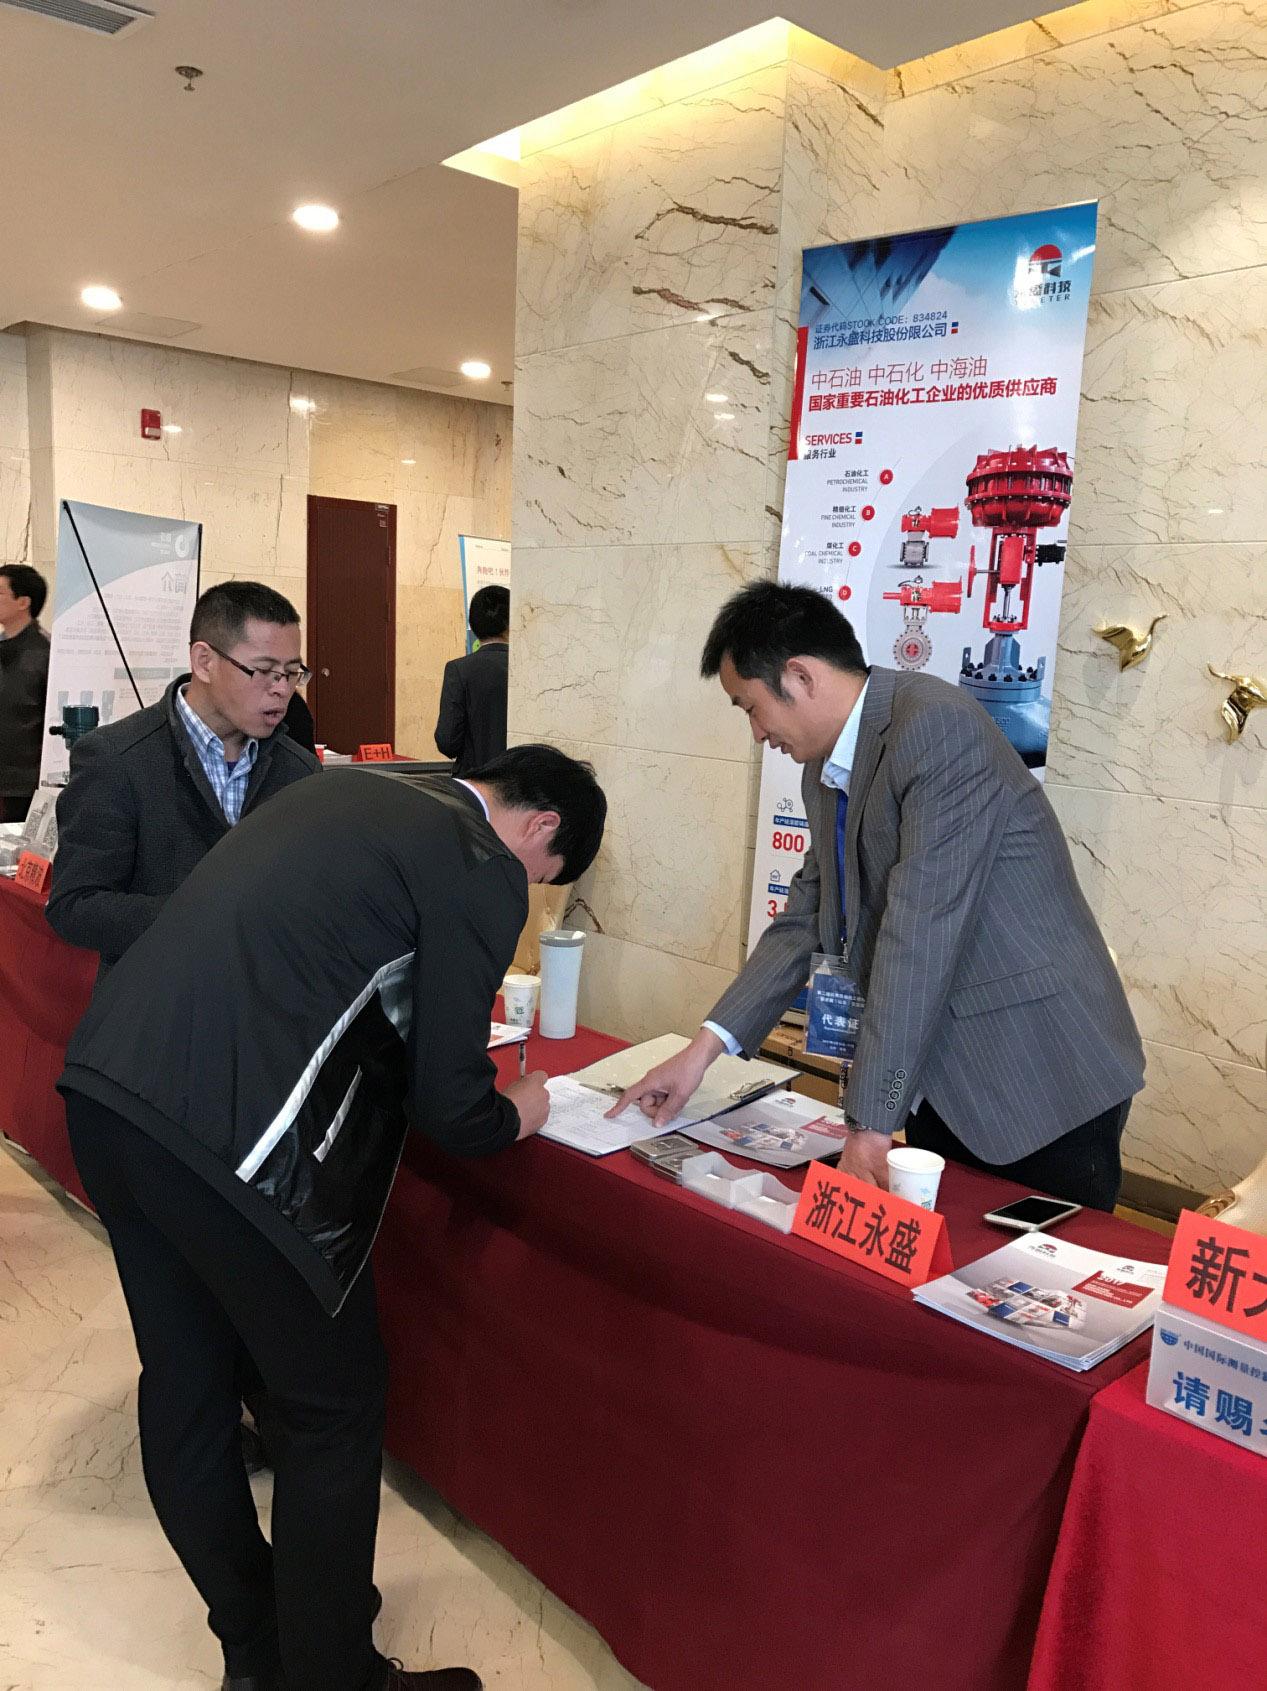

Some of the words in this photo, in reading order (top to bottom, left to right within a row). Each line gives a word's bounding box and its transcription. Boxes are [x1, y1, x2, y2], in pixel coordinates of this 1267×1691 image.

[912, 311, 947, 323] 834824
[811, 366, 862, 391] 中石油
[867, 361, 924, 385] 中石化
[930, 355, 988, 381] 中海油
[808, 376, 1059, 413] 国家重要石油化工企业的优质供应商
[804, 432, 853, 446] SERVICES
[772, 831, 805, 853] 800
[805, 1179, 923, 1275] 浙江永盛
[1172, 1371, 1267, 1437] 请赐
